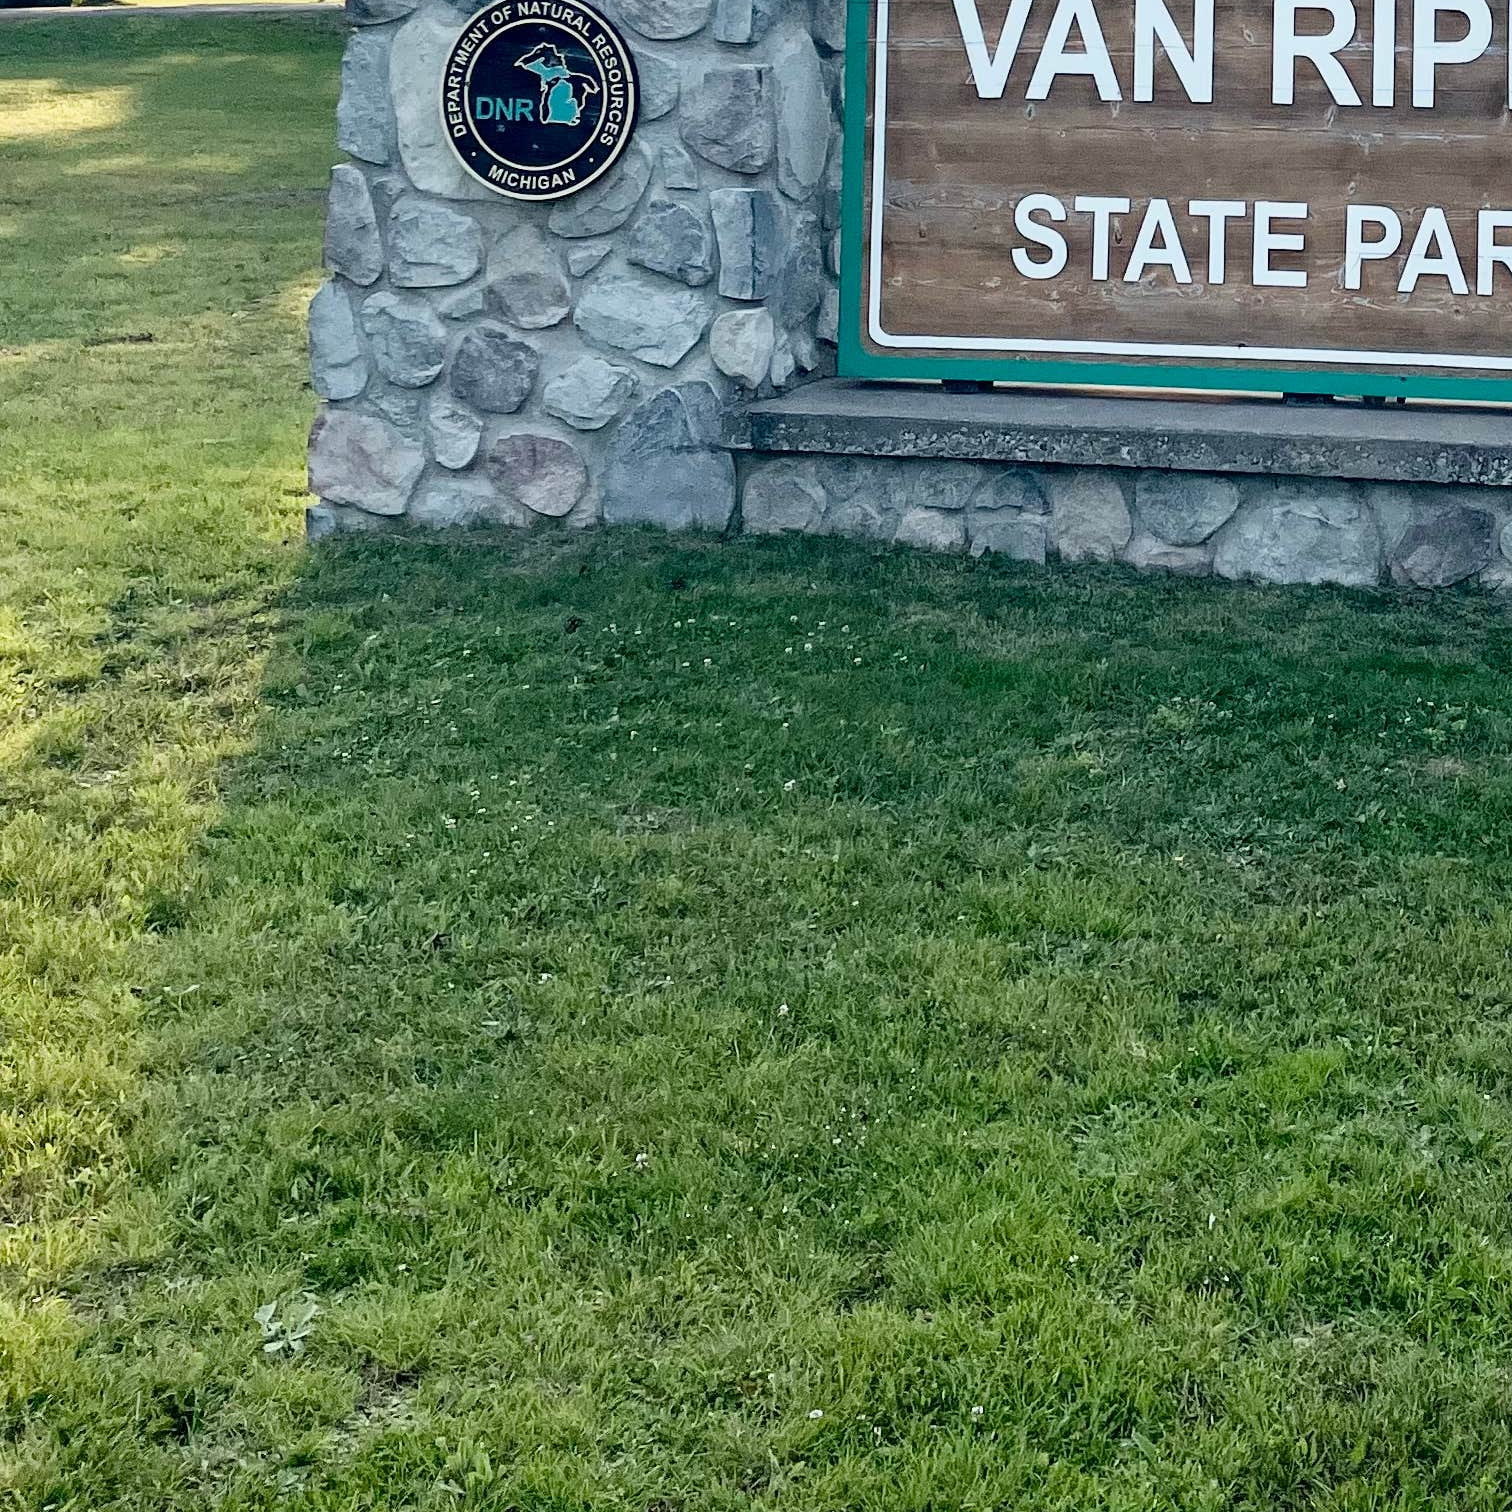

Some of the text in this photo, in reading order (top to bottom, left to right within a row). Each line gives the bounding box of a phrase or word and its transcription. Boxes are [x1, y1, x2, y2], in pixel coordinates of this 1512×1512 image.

[445, 1, 625, 147] DEPARTMENT OF NATURAL RESOURCES
[475, 96, 534, 122] DNR
[487, 164, 576, 190] MICHIGAN
[1010, 193, 1309, 288] STATE
